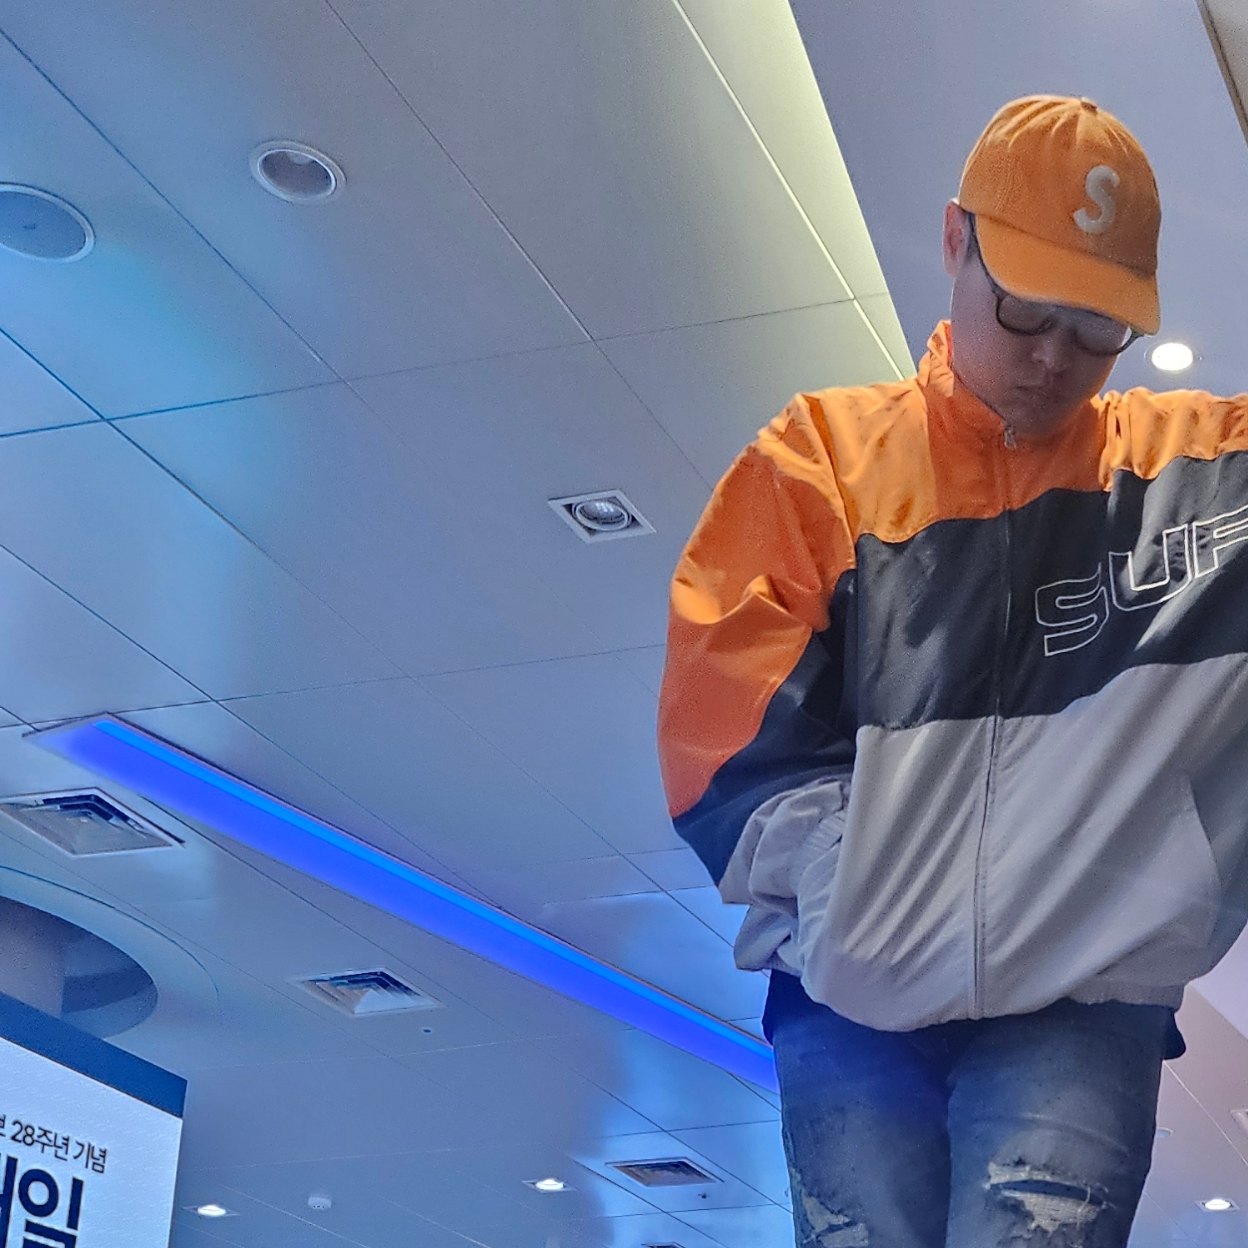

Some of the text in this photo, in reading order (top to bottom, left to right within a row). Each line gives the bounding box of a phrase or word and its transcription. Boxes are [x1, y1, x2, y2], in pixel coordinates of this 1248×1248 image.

[1073, 165, 1120, 235] S
[10, 1119, 70, 1162] 28주년
[73, 1139, 107, 1174] 기념
